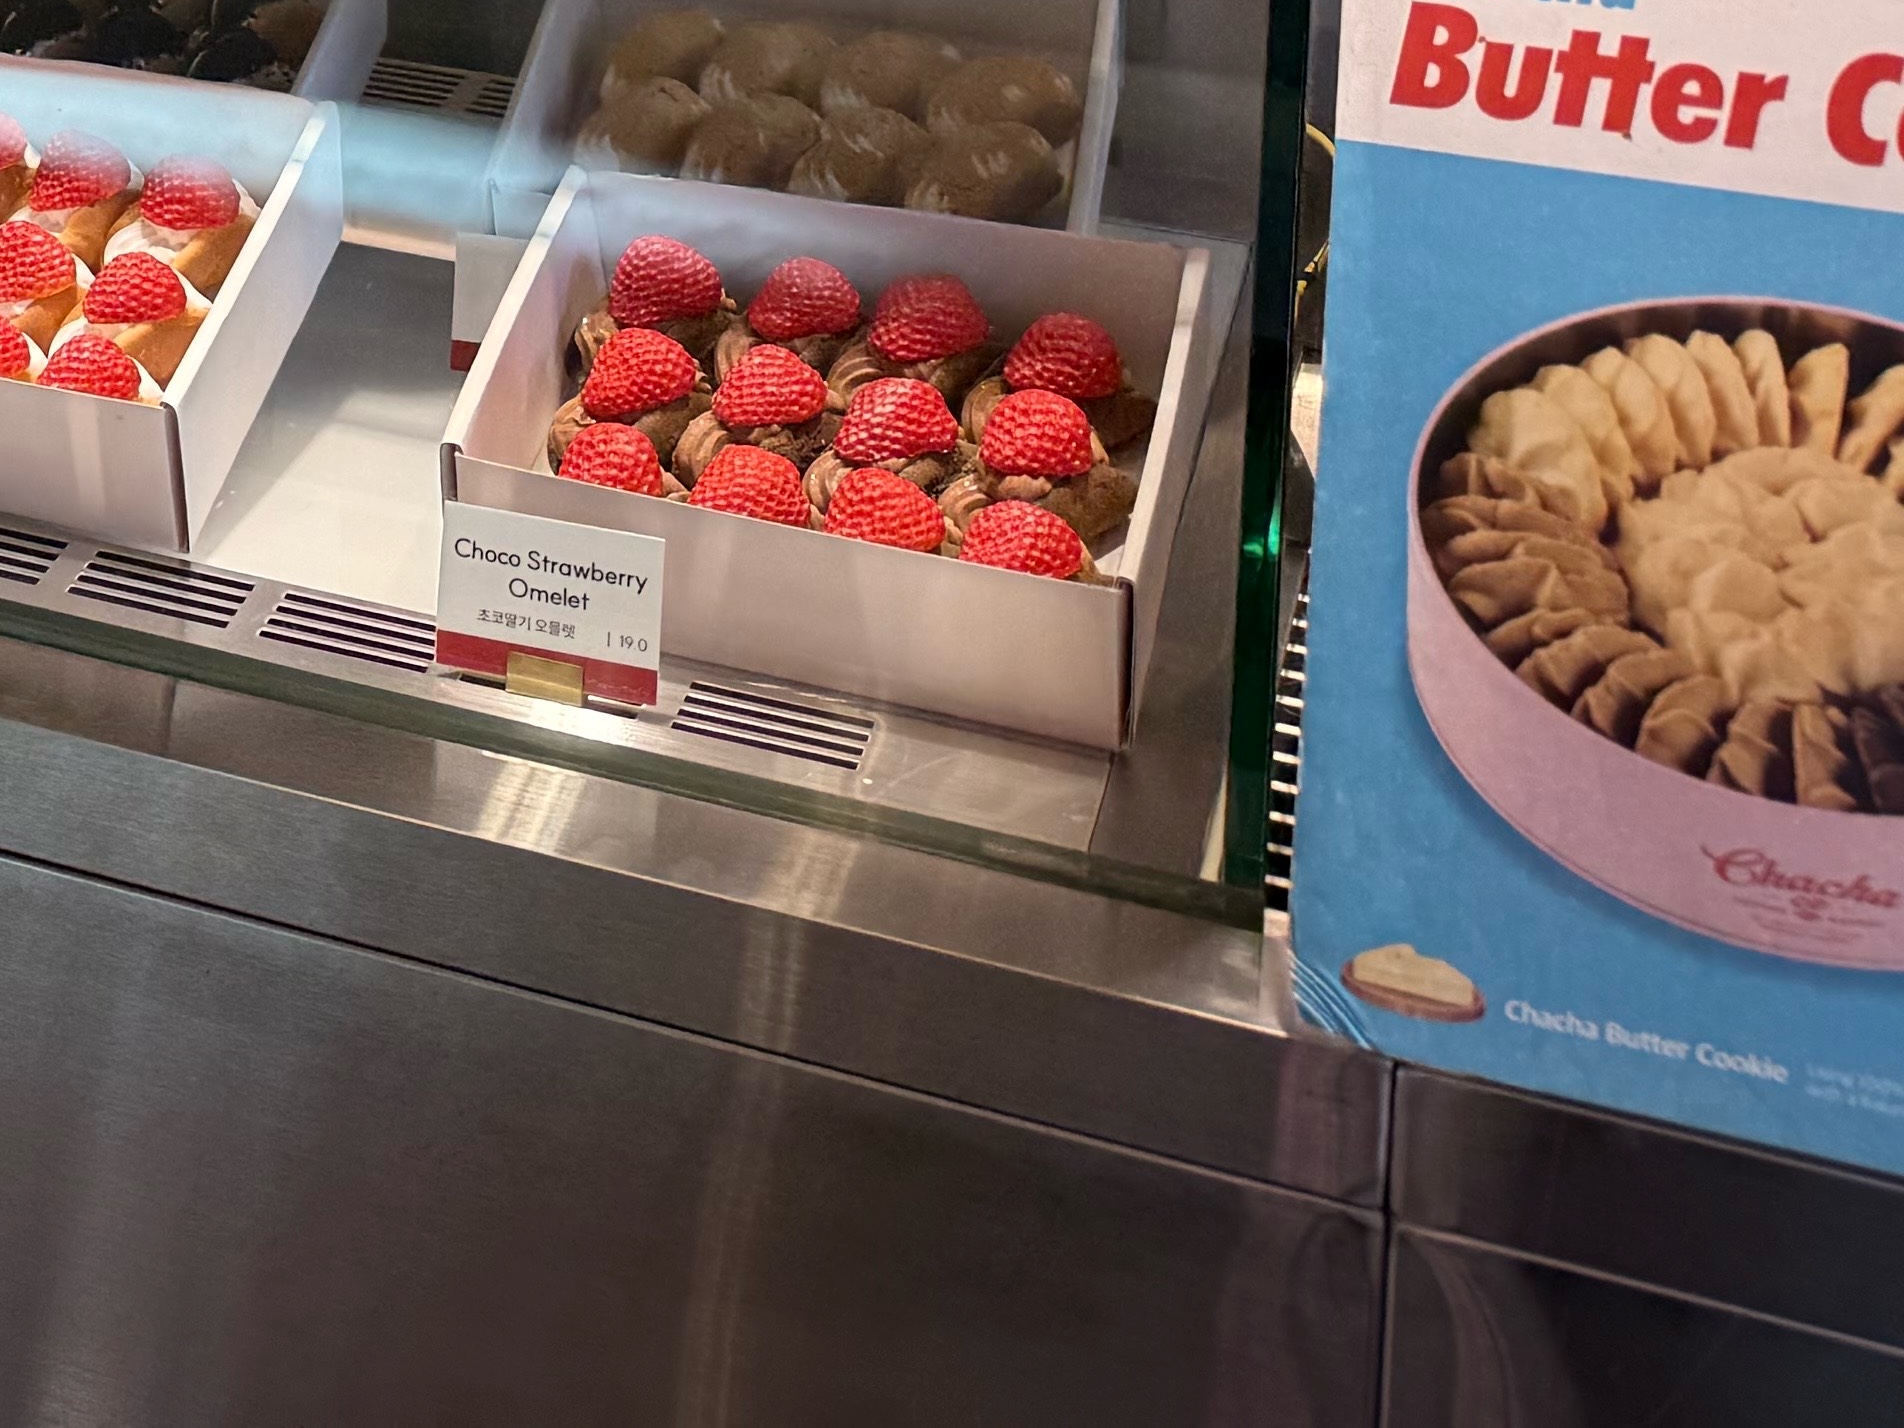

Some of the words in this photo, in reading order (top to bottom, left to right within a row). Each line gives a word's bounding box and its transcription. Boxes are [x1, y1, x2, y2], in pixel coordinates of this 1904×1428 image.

[1389, 1, 1789, 150] Butter
[454, 537, 521, 567] Choco
[527, 551, 647, 595] Strawberry
[509, 578, 590, 610] Omelet
[477, 609, 531, 631] 초코딸기
[535, 620, 576, 639] 오믈렛
[620, 634, 647, 652] 19.0
[1700, 844, 1900, 908] Chacha
[1504, 999, 1599, 1040] Chacha
[1605, 1021, 1688, 1060] Butter
[1696, 1042, 1789, 1085] Cookie
